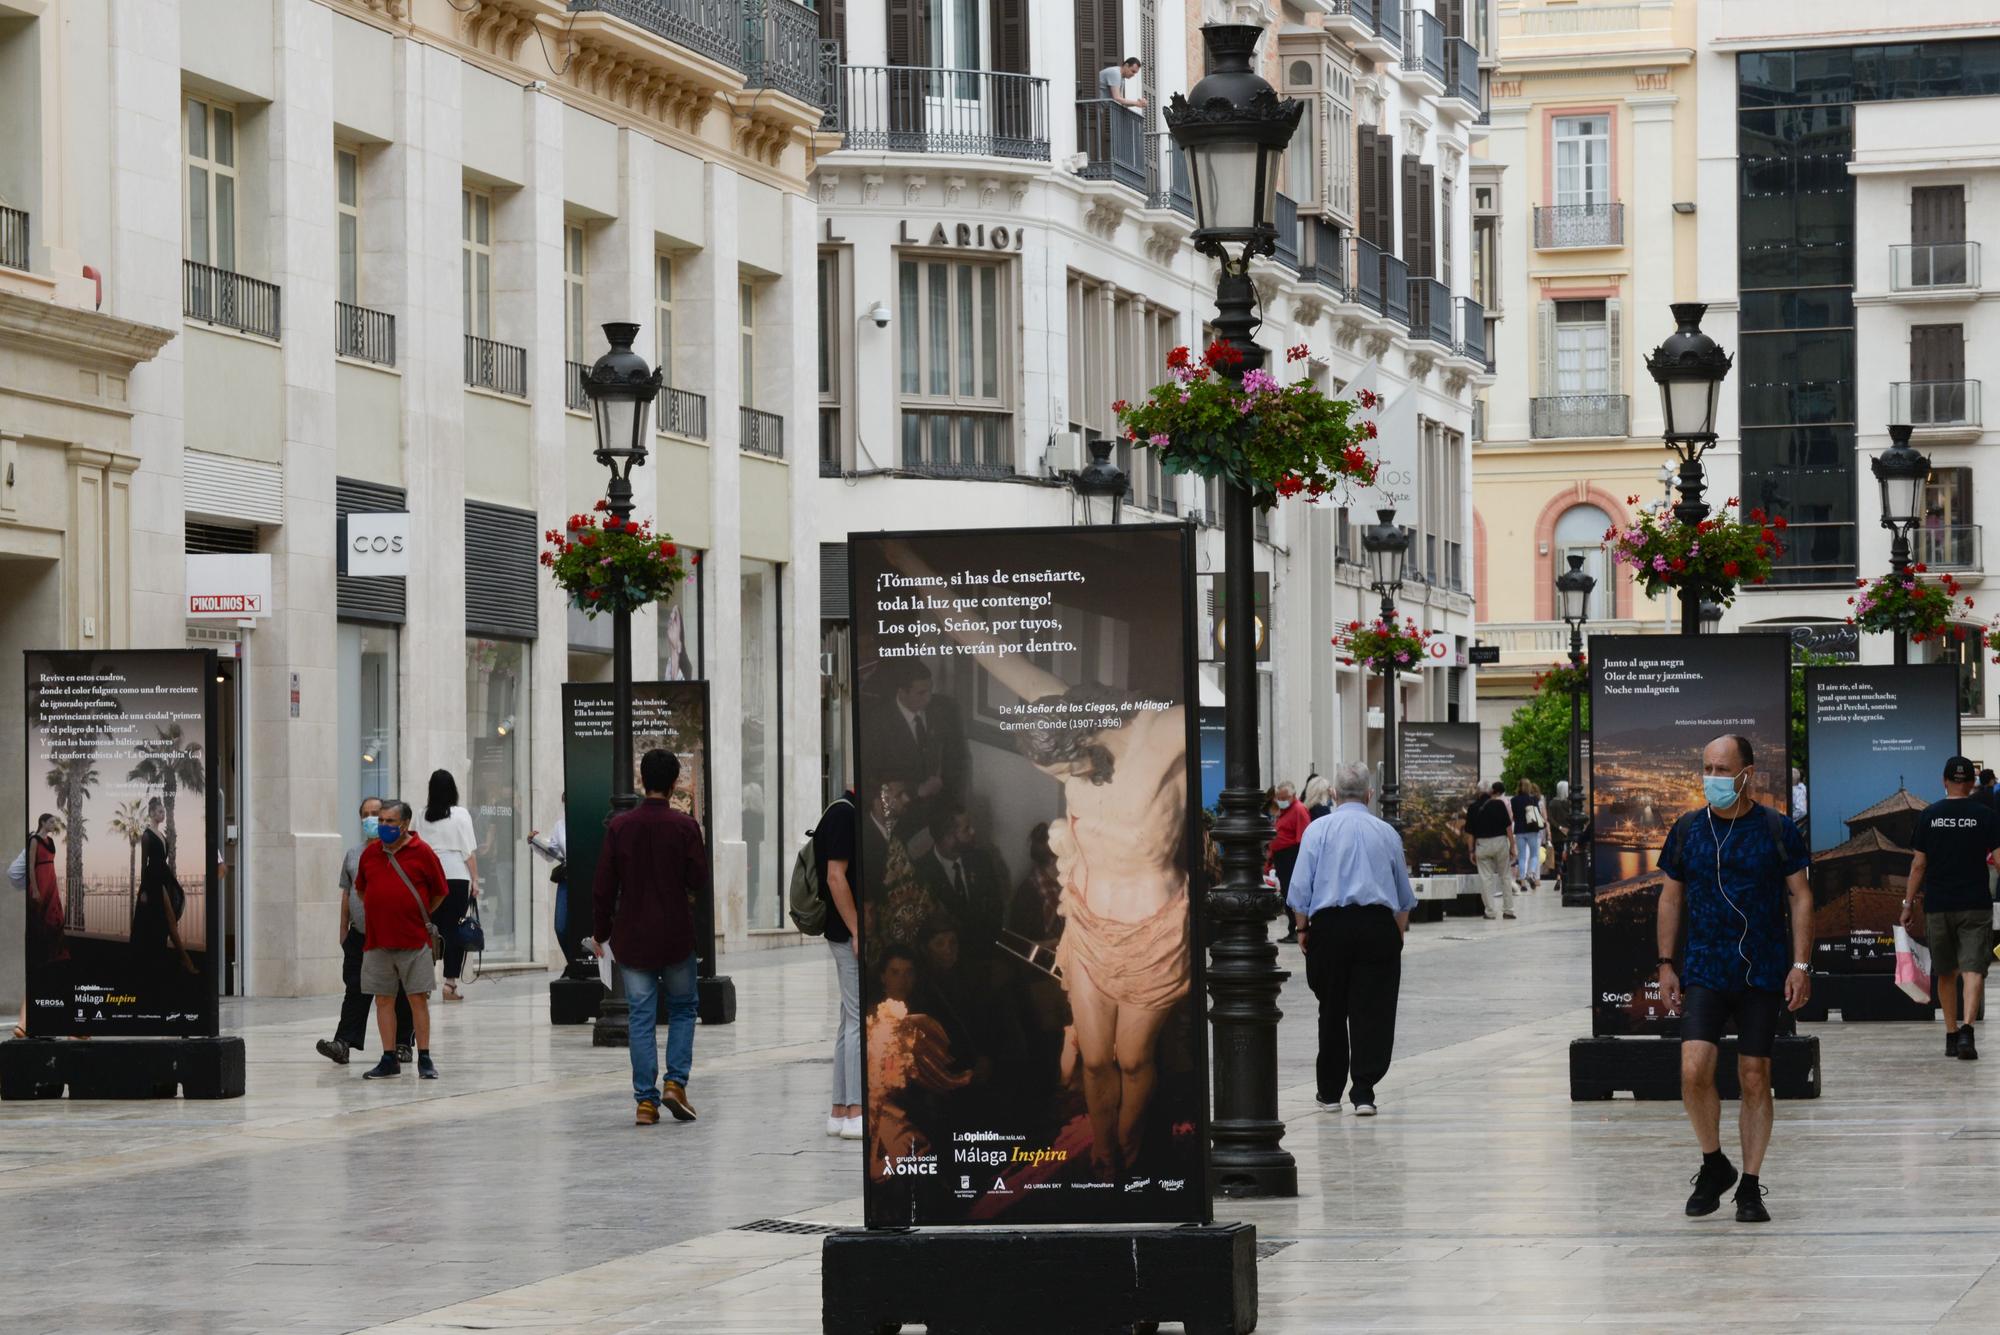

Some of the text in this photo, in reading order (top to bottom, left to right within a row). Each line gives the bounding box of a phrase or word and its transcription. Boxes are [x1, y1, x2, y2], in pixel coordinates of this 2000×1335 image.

[899, 220, 1024, 251] LARIOS
[352, 536, 404, 554] COS
[876, 568, 1086, 593] ¡Tómame, si has de enseñarte,
[192, 596, 243, 612] PIKOLINOS
[877, 591, 1052, 614] toda la luz que contengo!
[878, 617, 1063, 638] Los ojos, Señor, por tuyos,
[879, 638, 1078, 658] también te verán por dentro.
[1604, 659, 1685, 669] Junto al agua negra
[40, 674, 65, 683] Revive
[77, 674, 95, 682] estos
[96, 674, 126, 683] cuadros,
[1605, 672, 1625, 681] Olor
[1627, 672, 1637, 680] de
[1656, 674, 1662, 682] y
[1662, 672, 1704, 682] jazmines.
[40, 686, 63, 695] donde
[64, 686, 71, 695] el
[72, 686, 91, 695] color
[92, 686, 118, 695] fulgura
[119, 687, 139, 695] como
[155, 685, 168, 694] flor
[169, 686, 198, 694] reciente
[1605, 685, 1680, 696] Noche malagueña
[1859, 683, 1873, 691] aire,
[574, 700, 595, 709] Llegué
[644, 698, 668, 706] todavía.
[1817, 694, 1834, 703] igual
[1835, 695, 1847, 703] que
[40, 699, 117, 710] de ignorado perfume,
[999, 705, 1012, 715] De
[1027, 702, 1054, 714] Señor
[1056, 703, 1068, 713] de
[1070, 702, 1083, 713] los
[1085, 701, 1119, 715] Ciegos,
[1120, 701, 1133, 712] de
[1817, 705, 1835, 713] junto
[40, 712, 47, 721] la
[48, 713, 91, 723] provinciana
[92, 712, 119, 721] crónica
[120, 712, 129, 720] de
[144, 712, 169, 720] ciudad
[657, 709, 672, 717] Vaya
[602, 721, 612, 729] por
[632, 720, 642, 729] por
[650, 719, 669, 727] playa,
[999, 717, 1122, 731] Carmen Conde (1907-1996)
[40, 726, 49, 734] en
[50, 725, 57, 733] el
[58, 725, 85, 736] peligro
[85, 725, 95, 733] de
[95, 725, 102, 733] la
[575, 730, 593, 738] vayan
[650, 729, 667, 737] aquel
[40, 738, 47, 747] Y
[47, 738, 67, 747] están
[67, 738, 78, 747] las
[79, 738, 115, 747] baronesas
[116, 737, 143, 747] bálticas
[144, 740, 149, 748] y
[59, 751, 86, 760] confort
[1931, 818, 1977, 828] MBCS CAP
[1851, 936, 1876, 946] Málaga
[75, 993, 137, 1006] Málaga Inspira
[896, 1156, 917, 1164] grupo
[954, 1147, 1067, 1168] Málaga Inspira
[896, 1163, 937, 1175] ONCE
